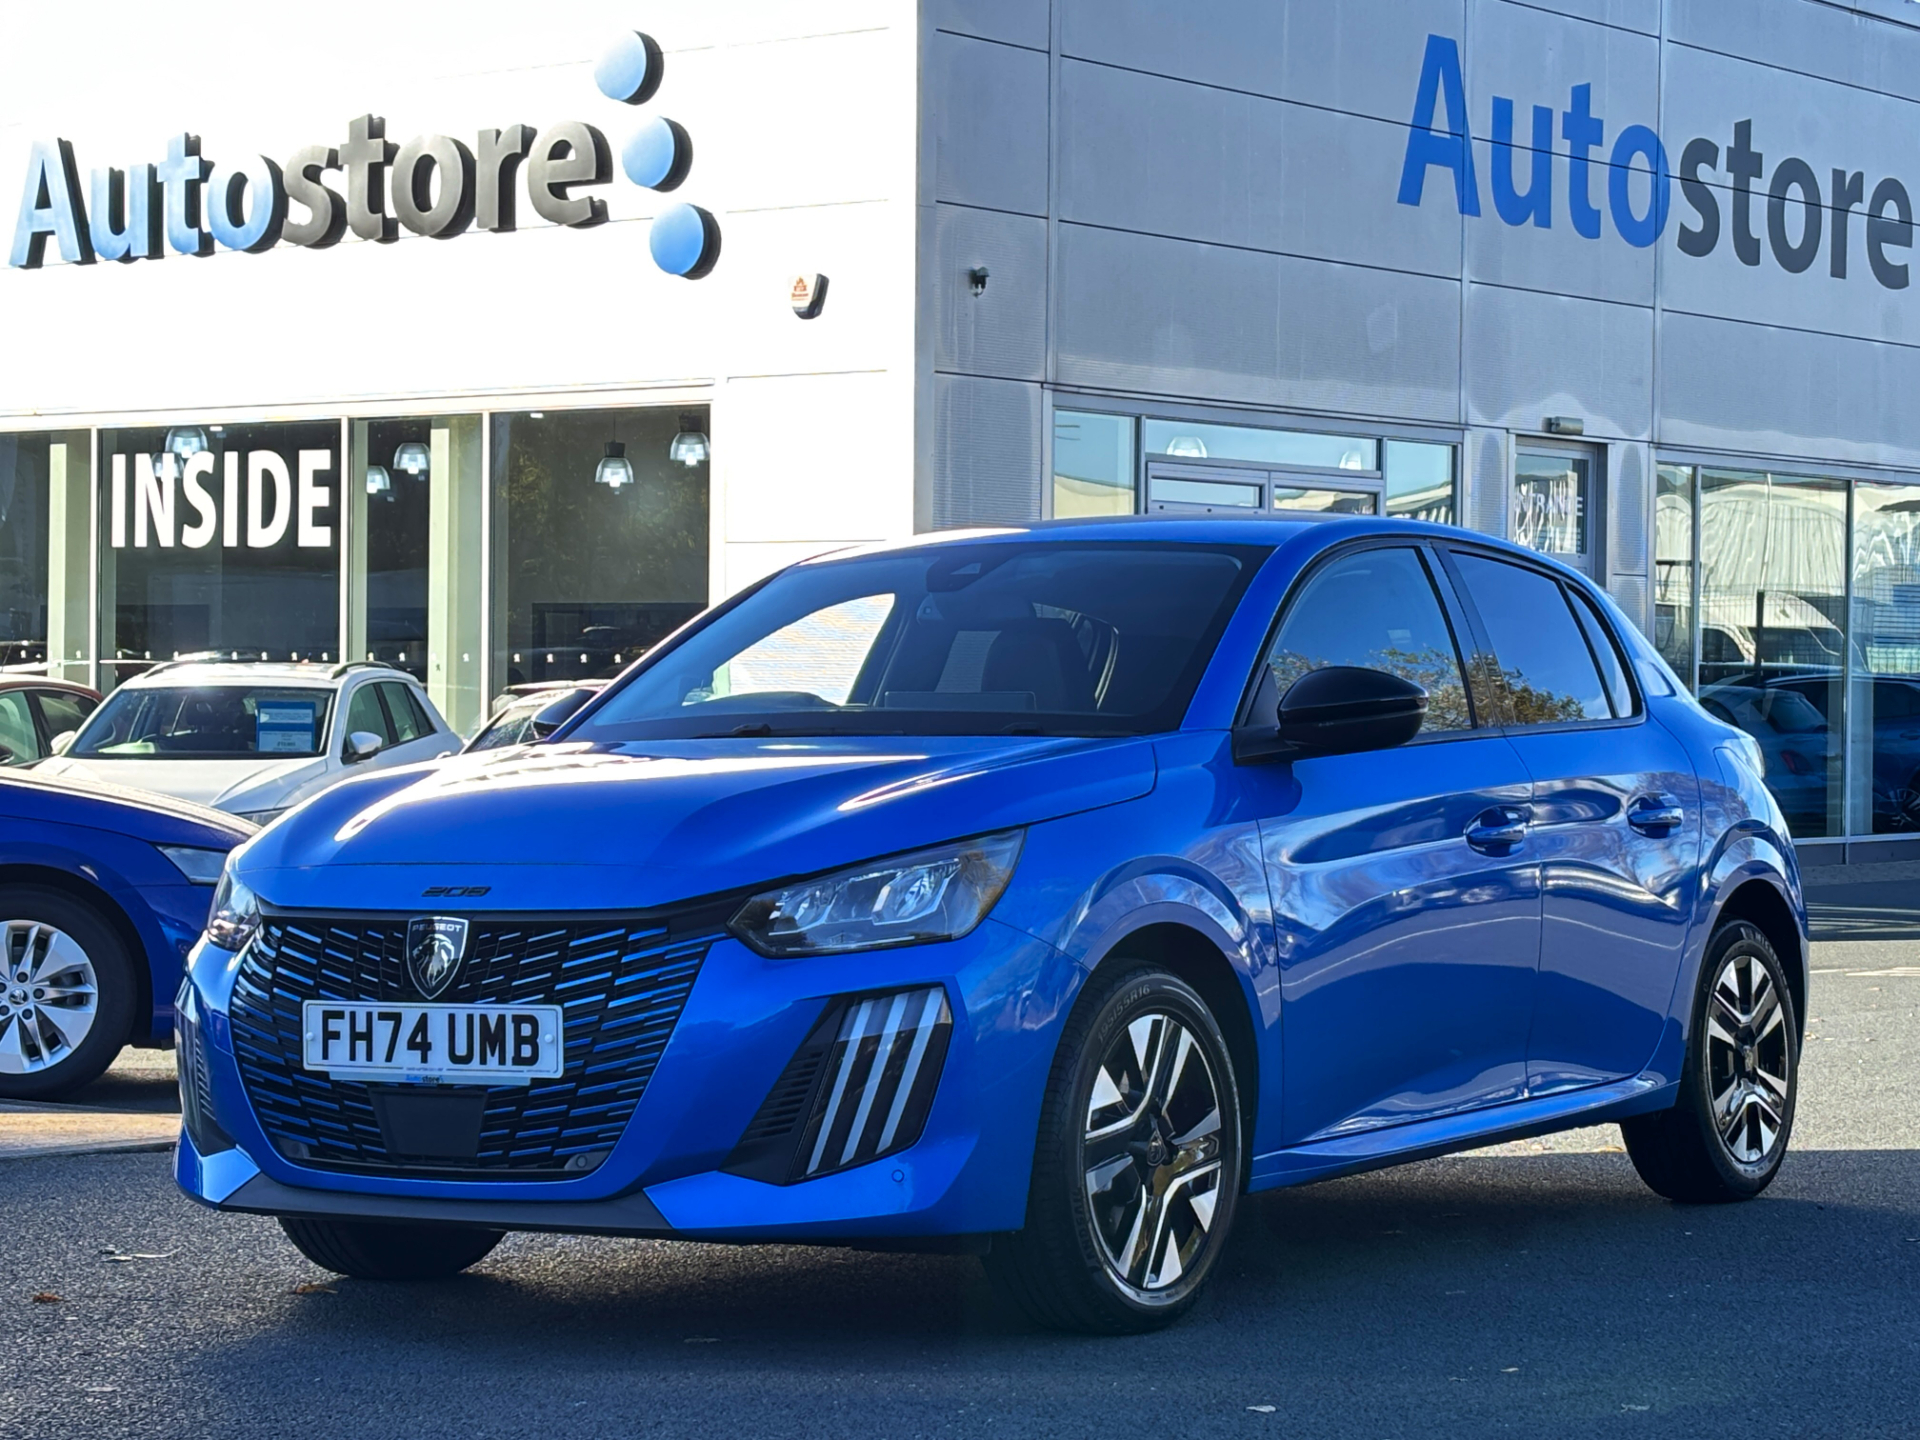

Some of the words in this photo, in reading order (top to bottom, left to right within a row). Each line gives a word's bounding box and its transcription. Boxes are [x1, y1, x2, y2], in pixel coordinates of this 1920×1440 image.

[9, 112, 610, 268] Autostore
[1397, 33, 1913, 290] Autostore
[111, 449, 332, 548] INSIDE
[412, 922, 463, 933] PEUGEOT
[421, 886, 491, 897] 208
[321, 1010, 433, 1064] FH74
[447, 1013, 540, 1066] UMB
